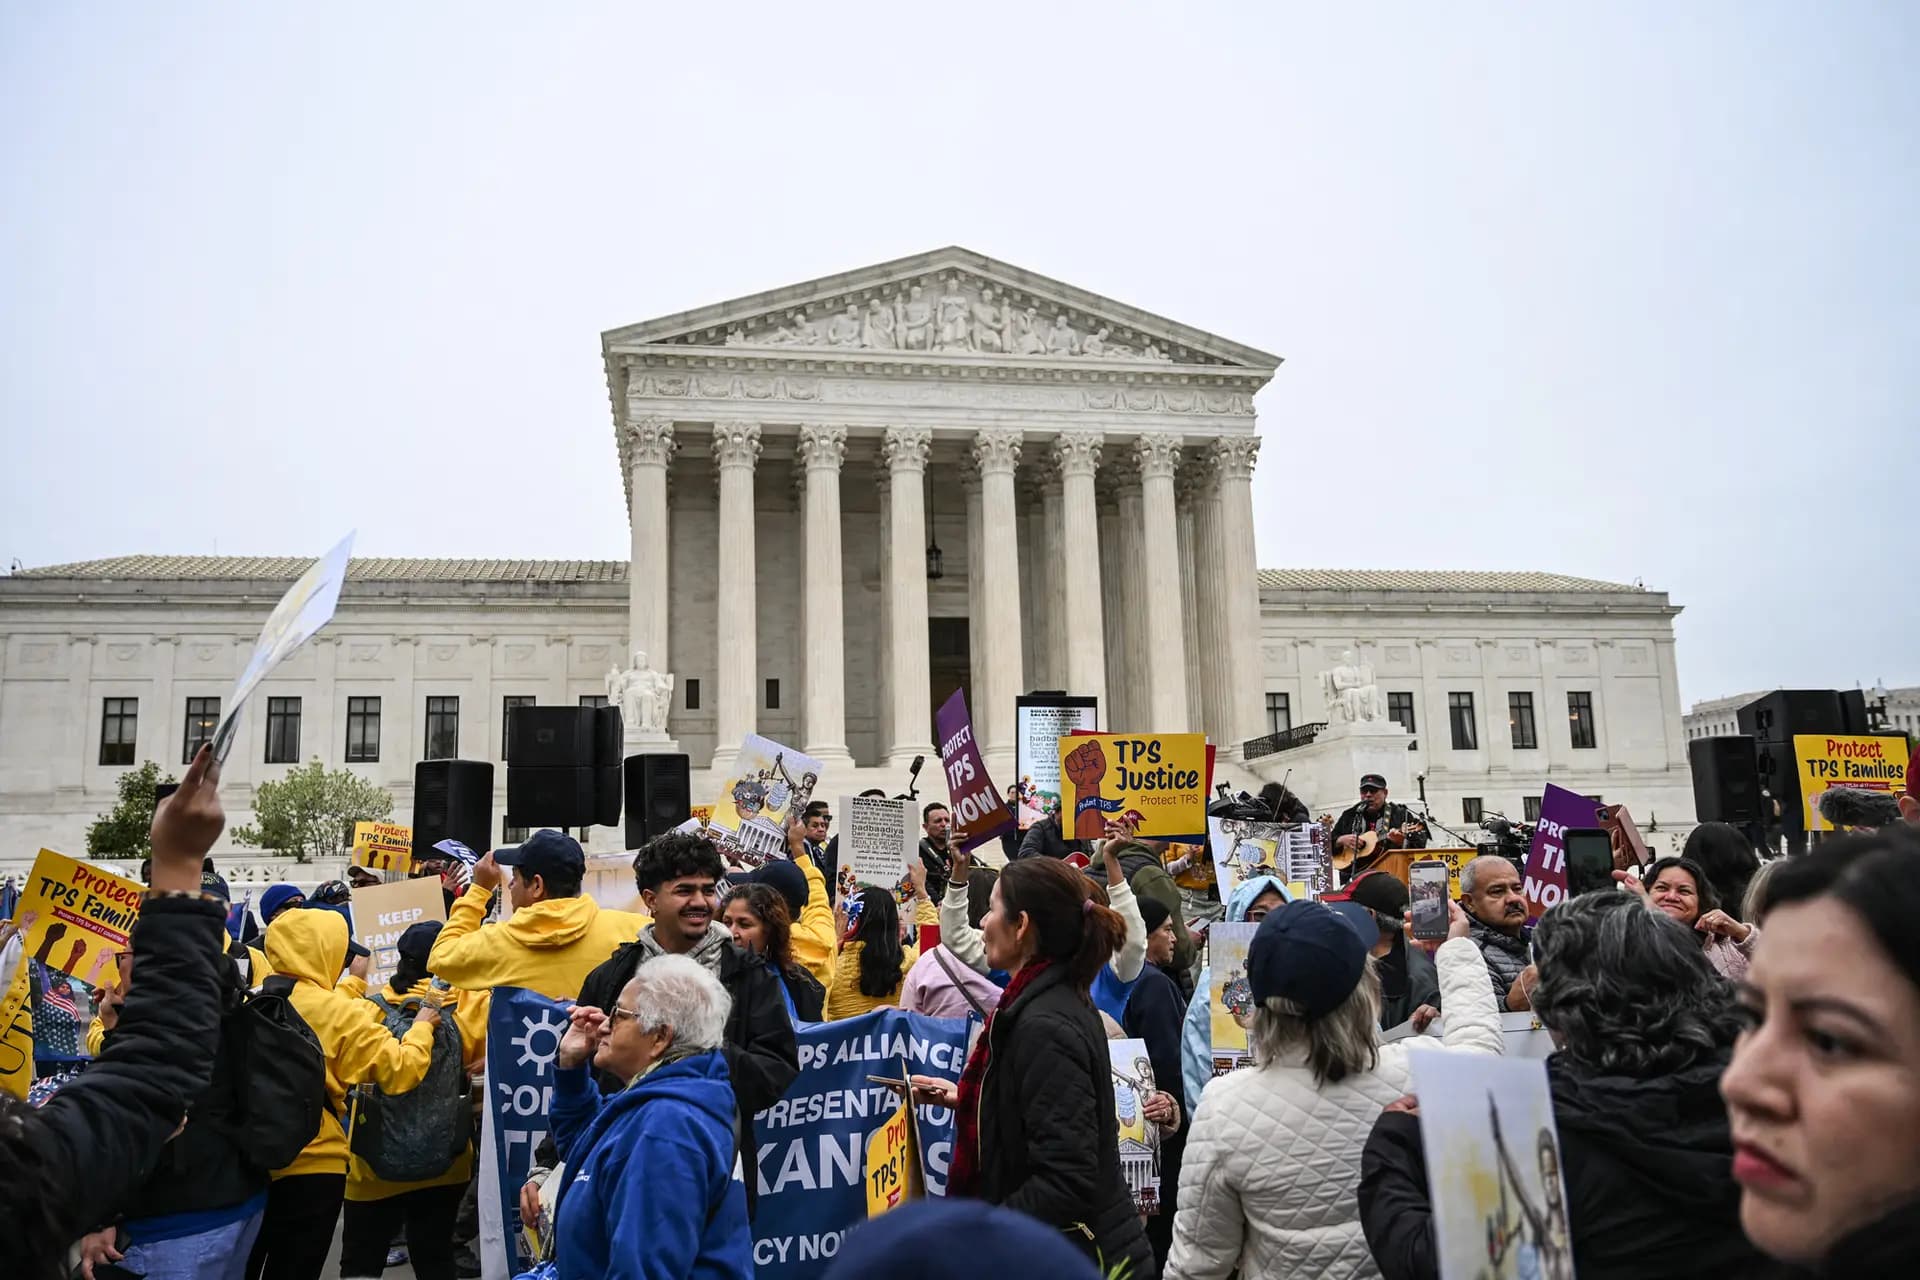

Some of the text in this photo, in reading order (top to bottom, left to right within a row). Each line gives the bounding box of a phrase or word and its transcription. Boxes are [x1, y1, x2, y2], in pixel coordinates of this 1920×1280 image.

[942, 725, 971, 762] PROTECT
[1113, 740, 1161, 764] TPS
[1826, 739, 1883, 758] Protect
[948, 753, 975, 791] TPS
[1115, 763, 1199, 791] Justice
[1806, 759, 1904, 778] TPS Families
[953, 786, 998, 829] NOW
[1099, 800, 1112, 810] TPS
[1140, 794, 1199, 806] Protect TPS
[360, 833, 413, 848] TPS Famili
[374, 824, 408, 838] Protect
[852, 824, 904, 835] badbaadiya
[40, 877, 79, 907] TPS
[1522, 876, 1569, 909] NO
[378, 907, 423, 926] KEEP
[797, 1033, 963, 1073] PS ALLIANCE
[886, 1108, 907, 1153] Pro
[757, 1132, 952, 1197] KANS
[872, 1156, 897, 1198] TPS
[799, 1230, 845, 1261] NO
